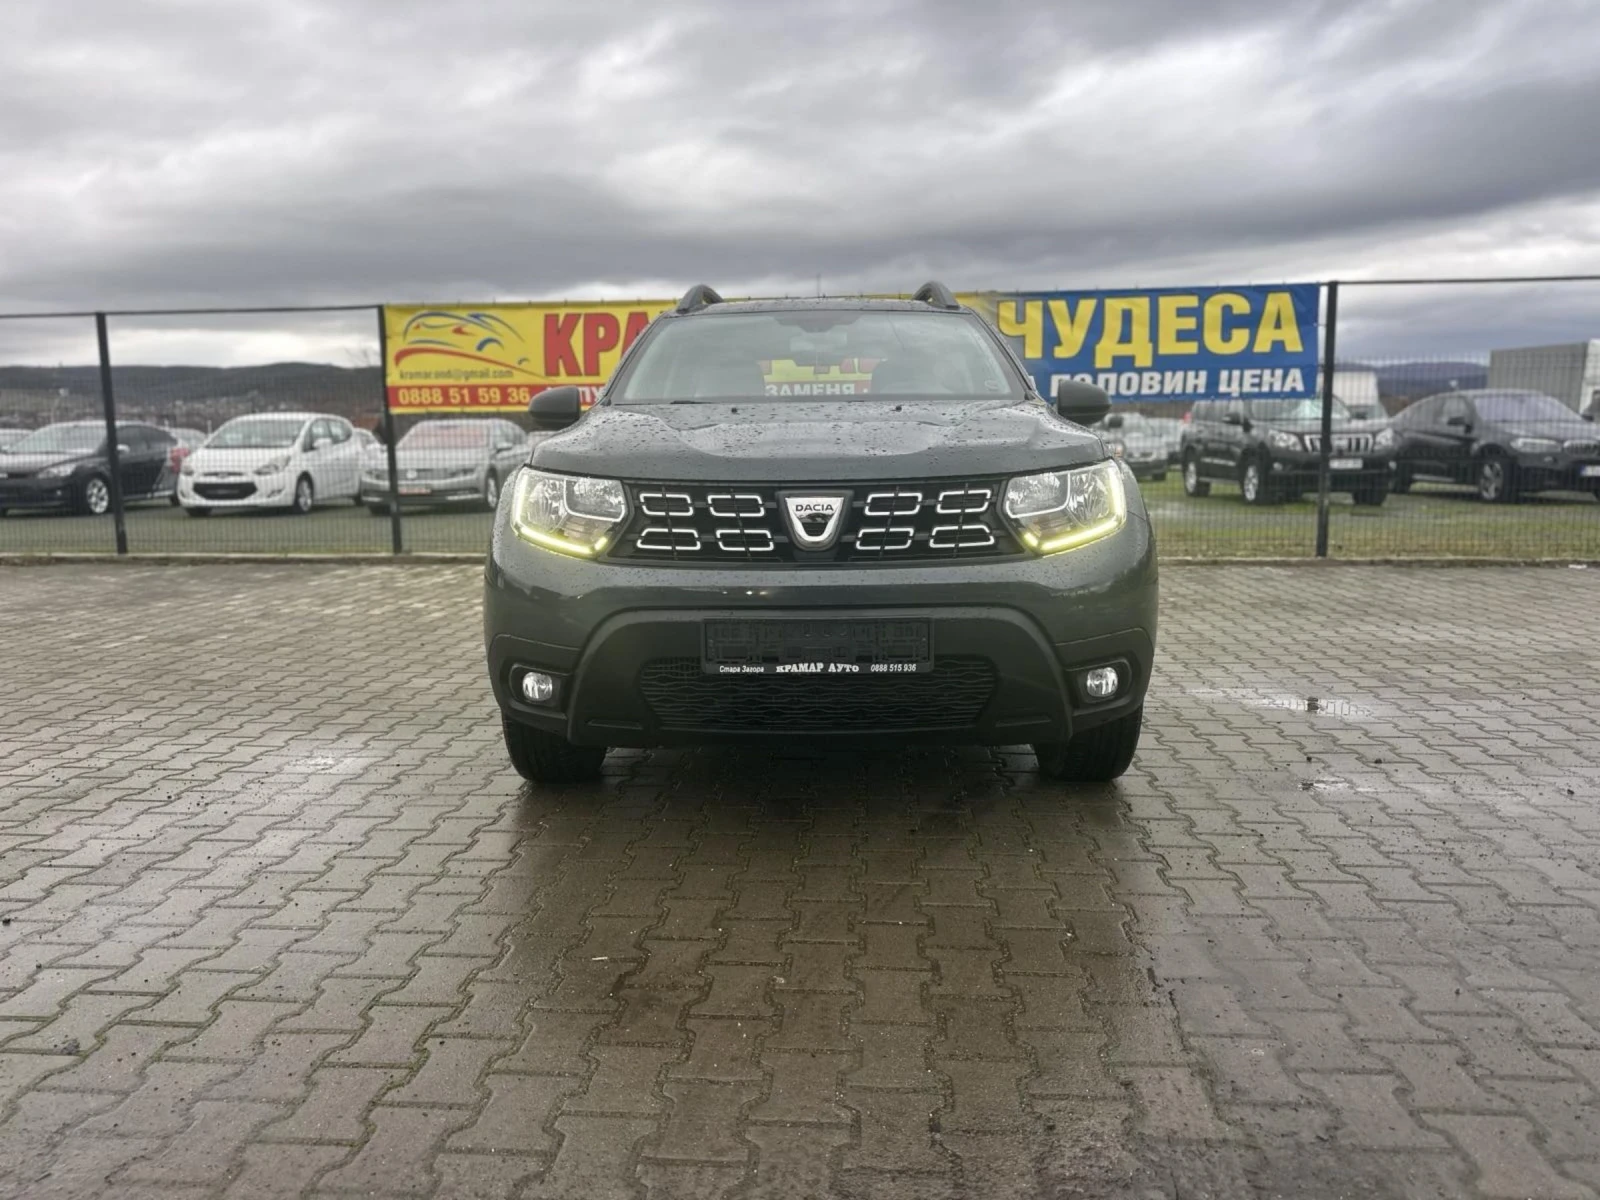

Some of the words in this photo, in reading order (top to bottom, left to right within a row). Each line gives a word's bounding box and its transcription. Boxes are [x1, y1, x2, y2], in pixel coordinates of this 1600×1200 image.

[996, 292, 1303, 368] ЧУДЕСА
[1218, 368, 1305, 397] ЦЕНА
[398, 387, 443, 405] 0888
[449, 386, 470, 404] 51
[478, 386, 501, 404] 59
[507, 386, 530, 404] 36
[795, 503, 834, 512] DACIA
[719, 665, 741, 674] Стара
[741, 665, 765, 674] Загора
[775, 662, 824, 673] КРАМАР
[870, 663, 888, 672] 0888
[889, 663, 902, 672] 515
[903, 663, 917, 672] 936
